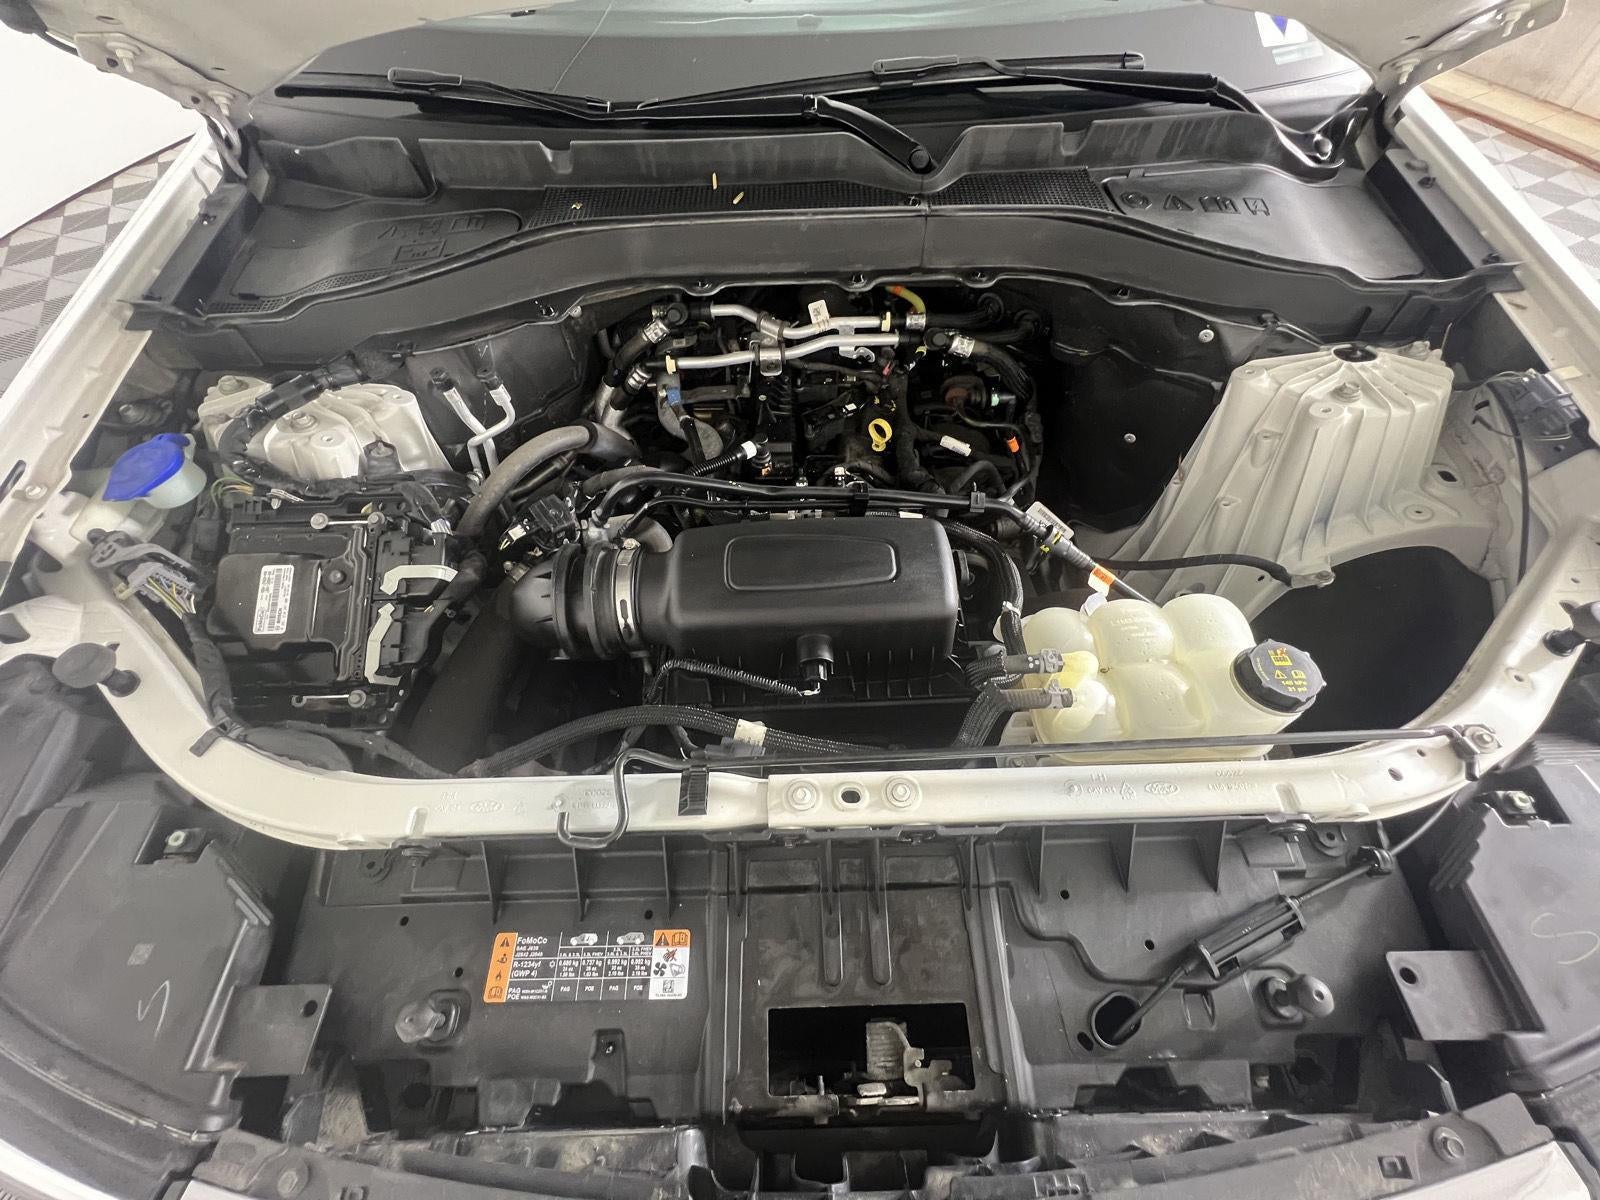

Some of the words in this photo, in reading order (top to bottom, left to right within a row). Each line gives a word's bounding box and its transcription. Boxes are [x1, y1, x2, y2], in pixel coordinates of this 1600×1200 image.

[516, 936, 548, 945] FoMoCo
[513, 961, 541, 969] R-1234yf
[511, 970, 530, 978] (GWP
